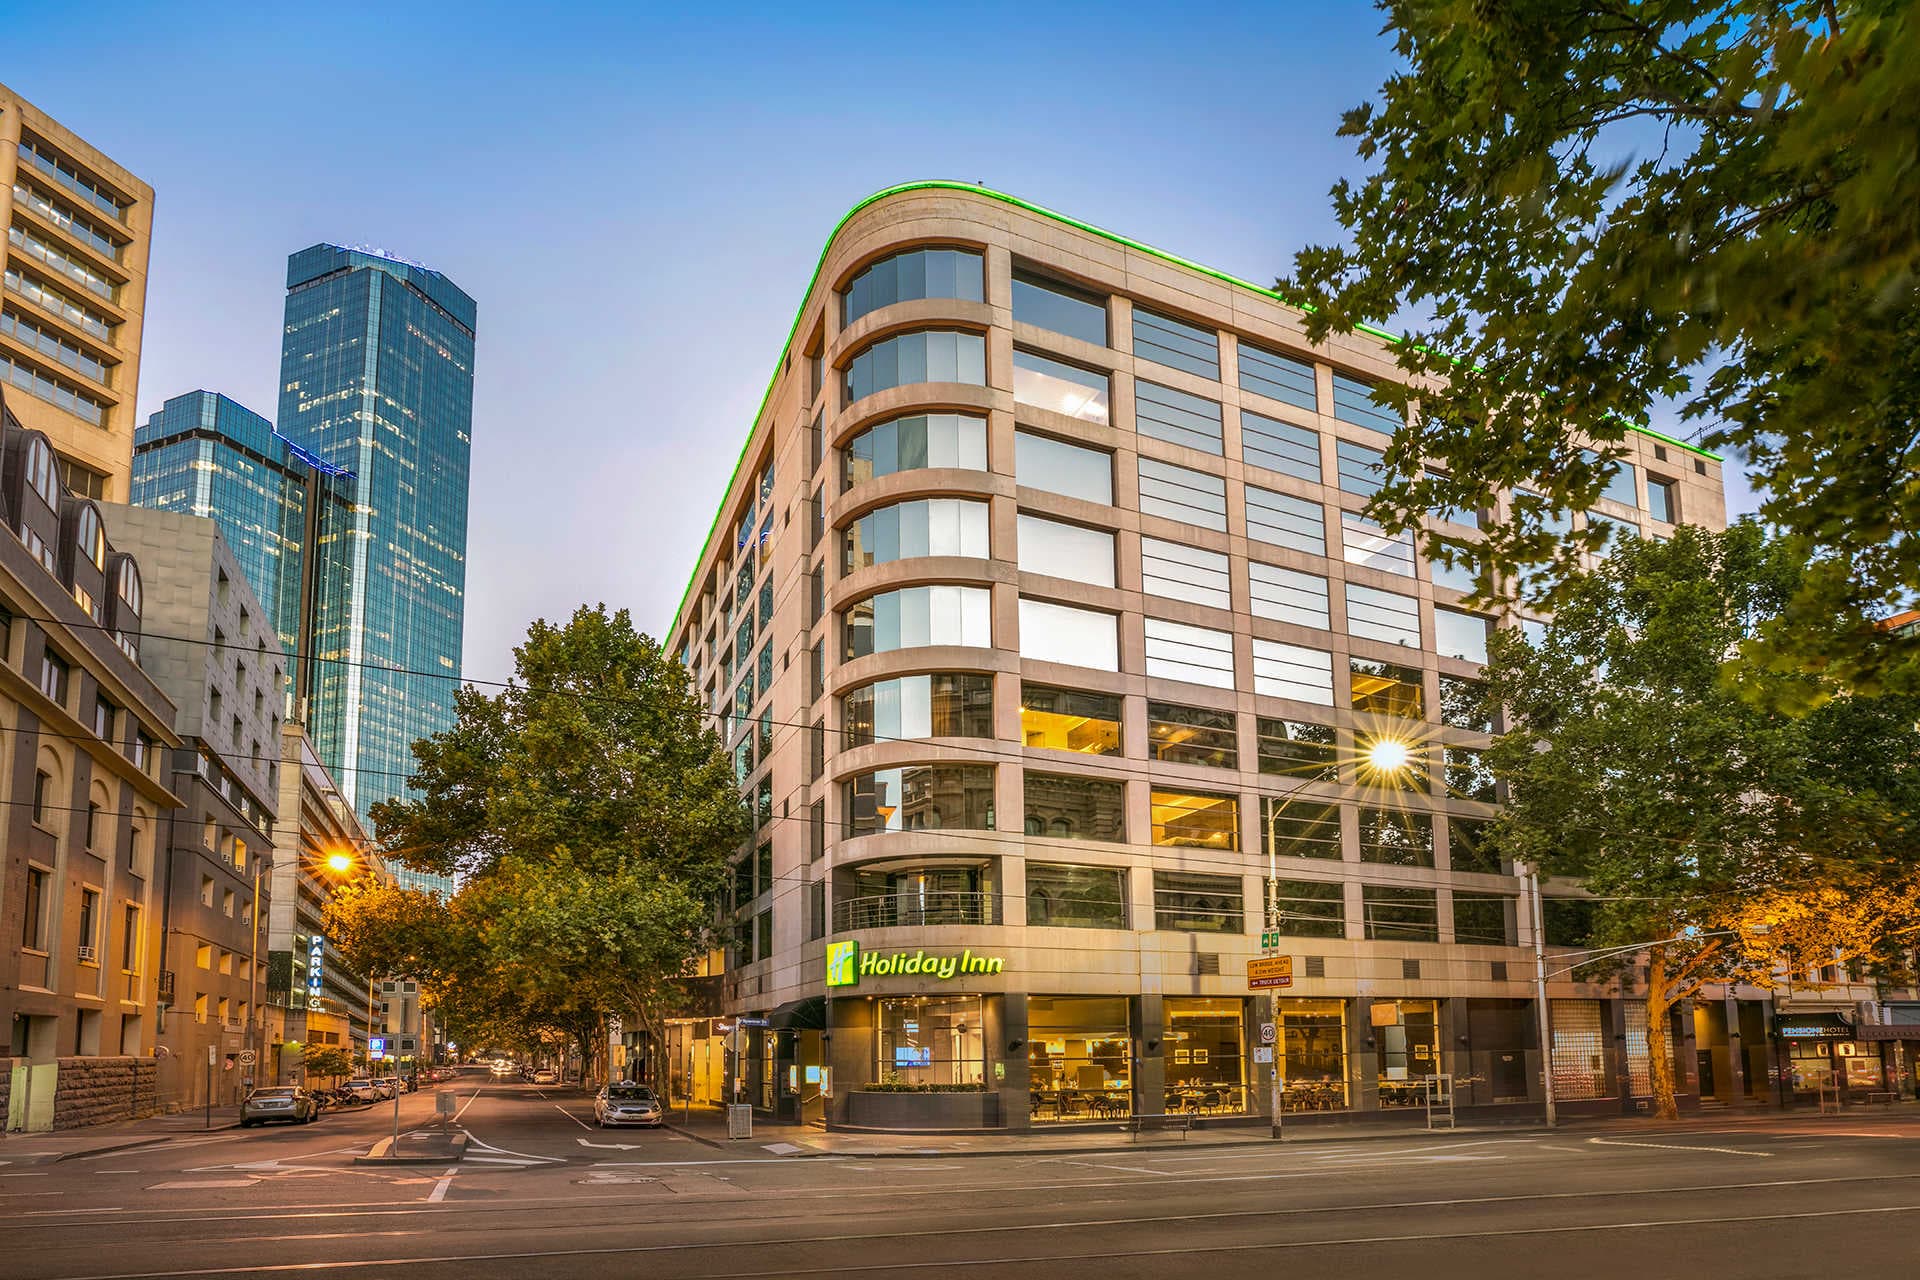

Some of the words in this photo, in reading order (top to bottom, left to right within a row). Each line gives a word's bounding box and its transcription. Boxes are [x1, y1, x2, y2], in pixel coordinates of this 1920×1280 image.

[310, 936, 322, 1007] PARKING
[860, 951, 956, 979] Holiday
[961, 950, 1002, 973] Inn
[242, 1053, 253, 1061] 40
